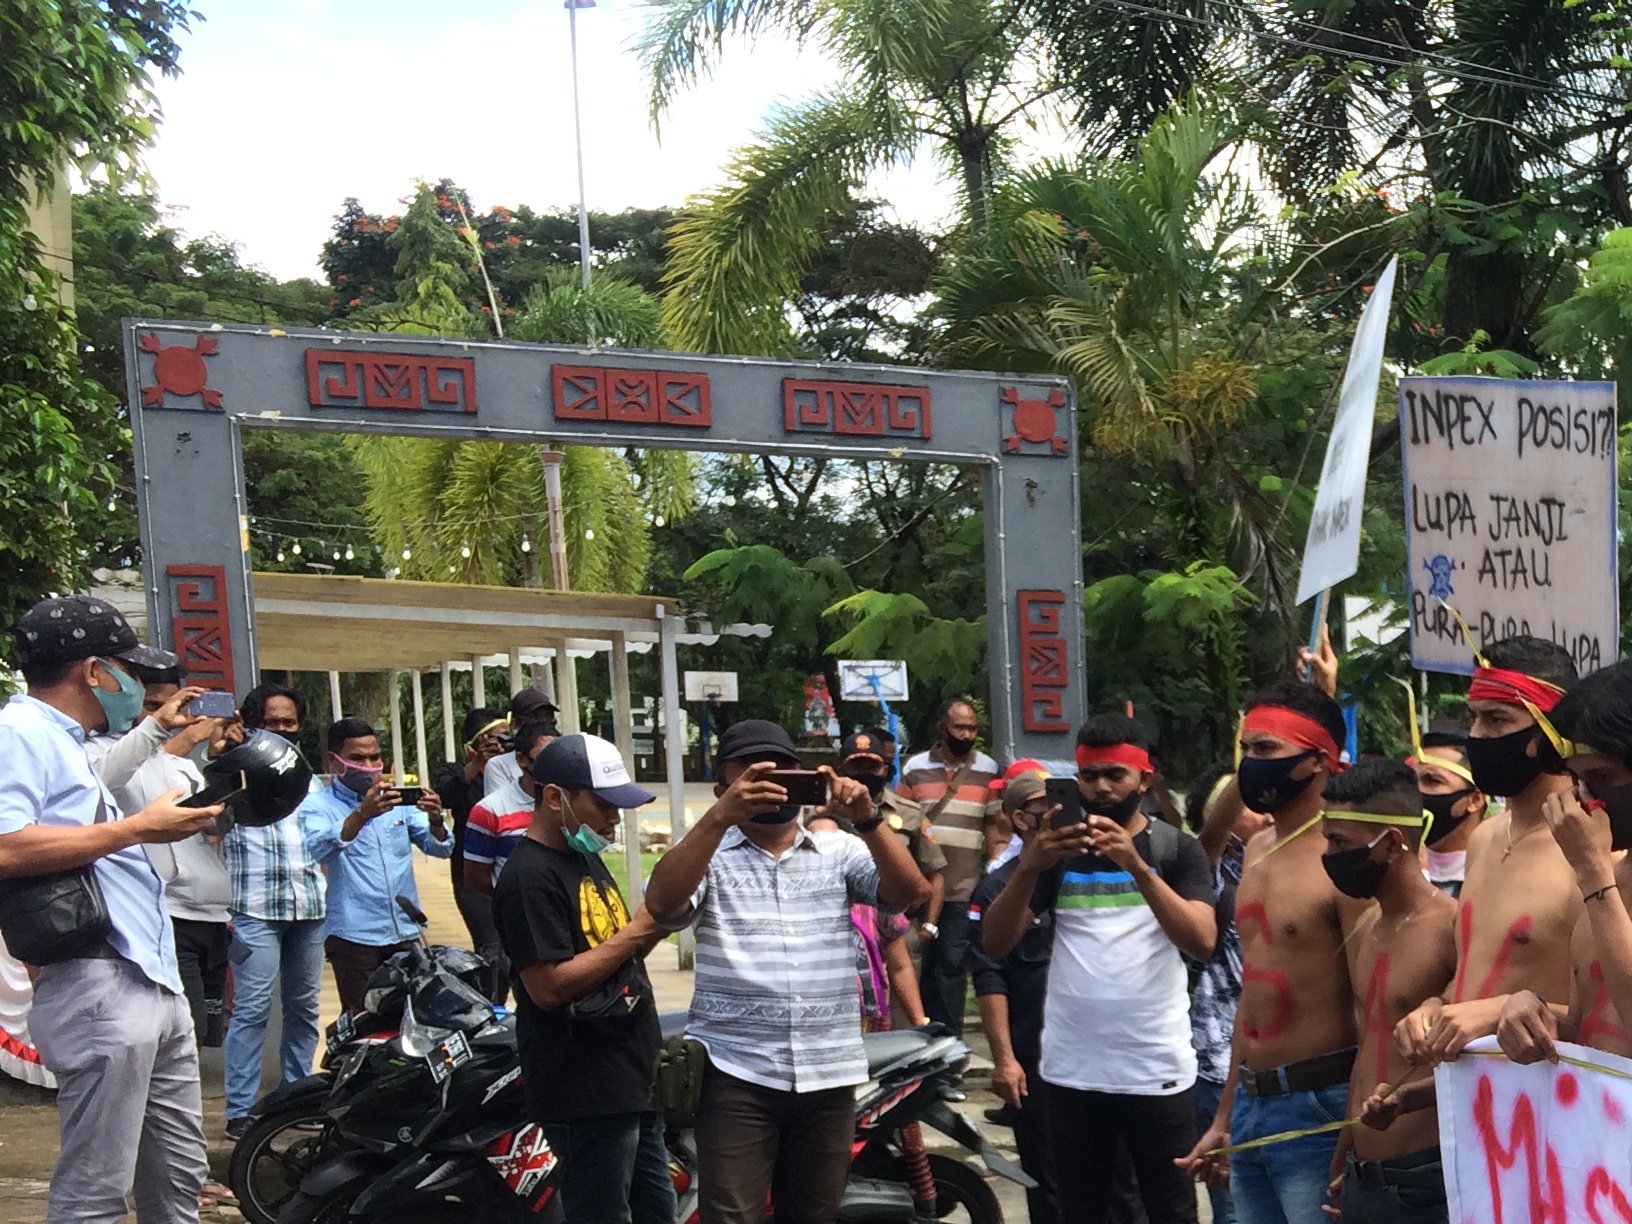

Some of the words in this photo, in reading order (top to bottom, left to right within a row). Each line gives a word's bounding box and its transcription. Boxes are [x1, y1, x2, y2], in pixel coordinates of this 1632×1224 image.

[1405, 389, 1498, 451] INPEX
[1412, 483, 1478, 541] LUPA
[1488, 494, 1569, 547] JANJI
[1477, 546, 1552, 591] ATAU
